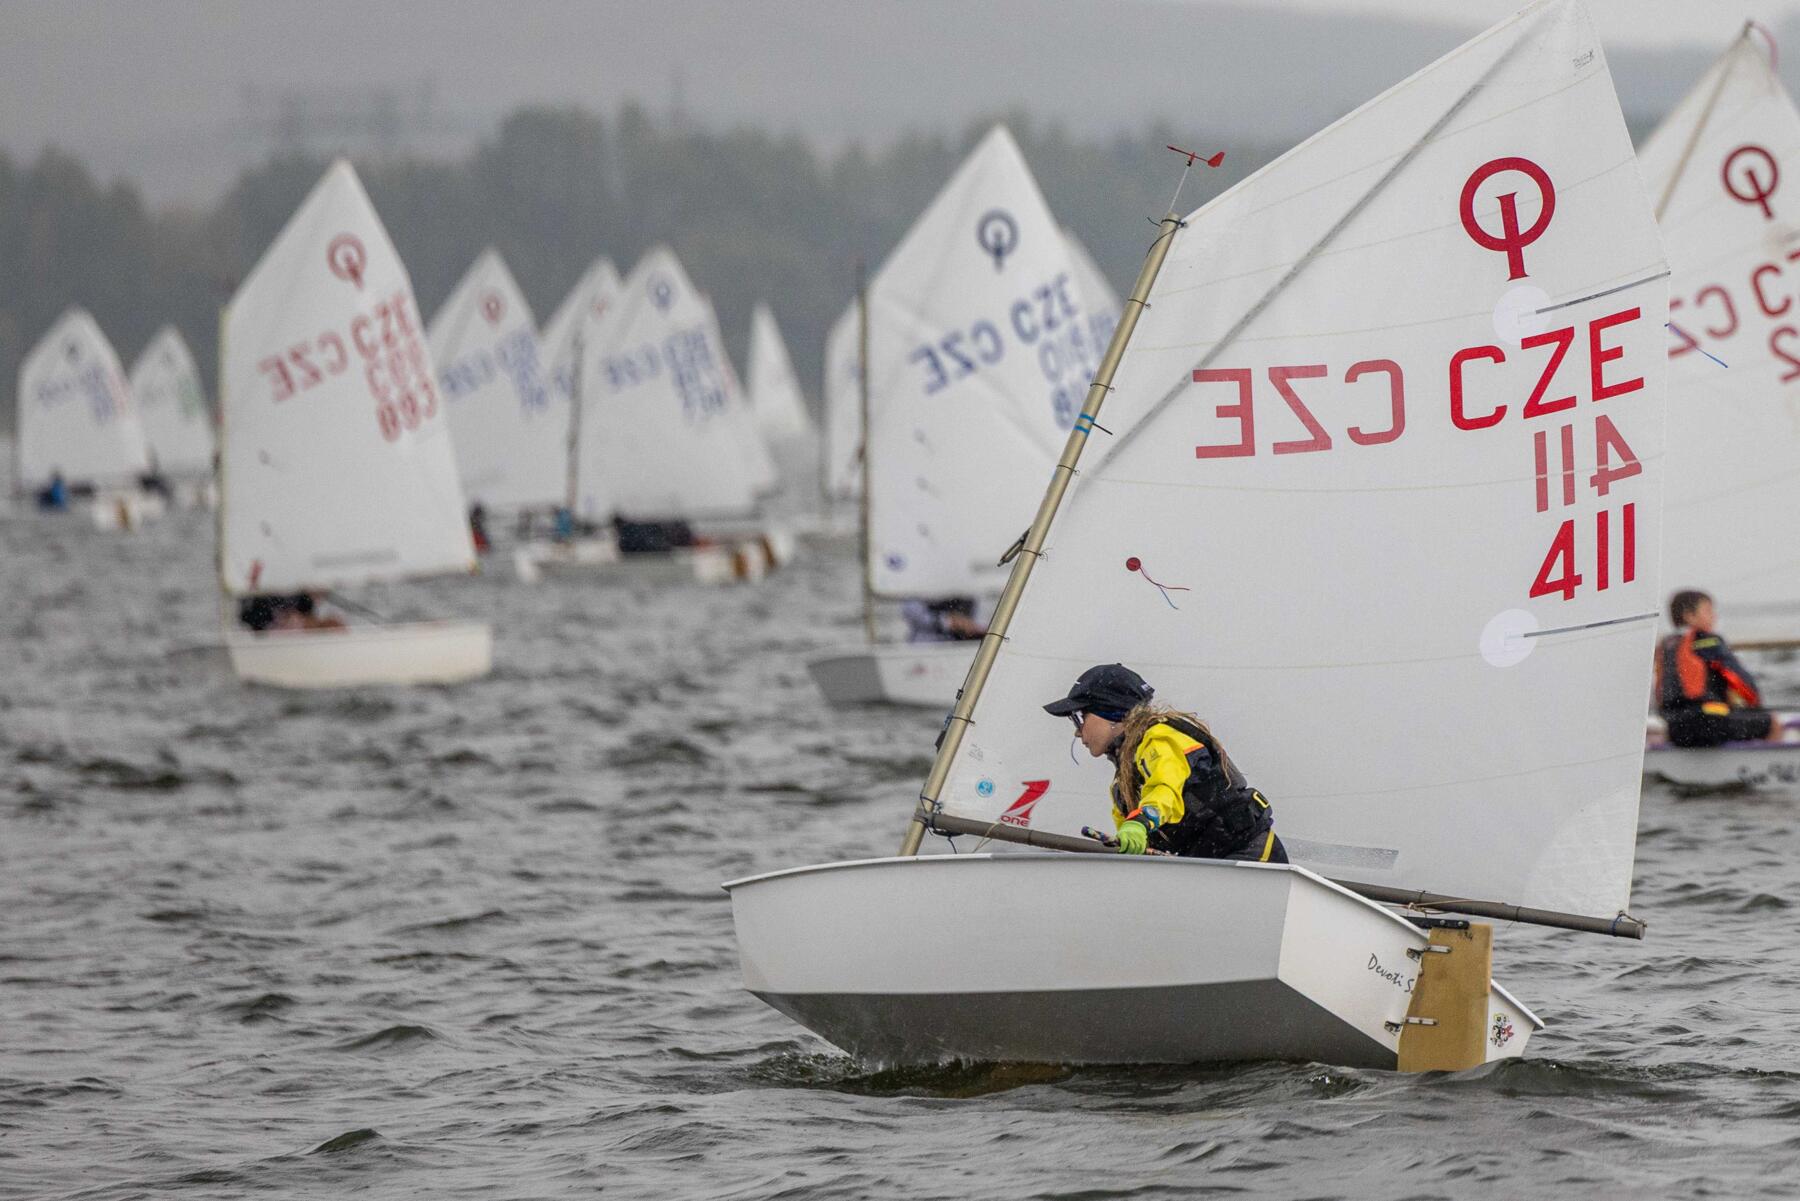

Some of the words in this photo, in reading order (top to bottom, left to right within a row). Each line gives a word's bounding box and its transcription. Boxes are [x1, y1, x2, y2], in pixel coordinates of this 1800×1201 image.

[1449, 306, 1645, 431] CZE
[1529, 502, 1636, 601] 411
[1367, 952, 1404, 987] Devoti
